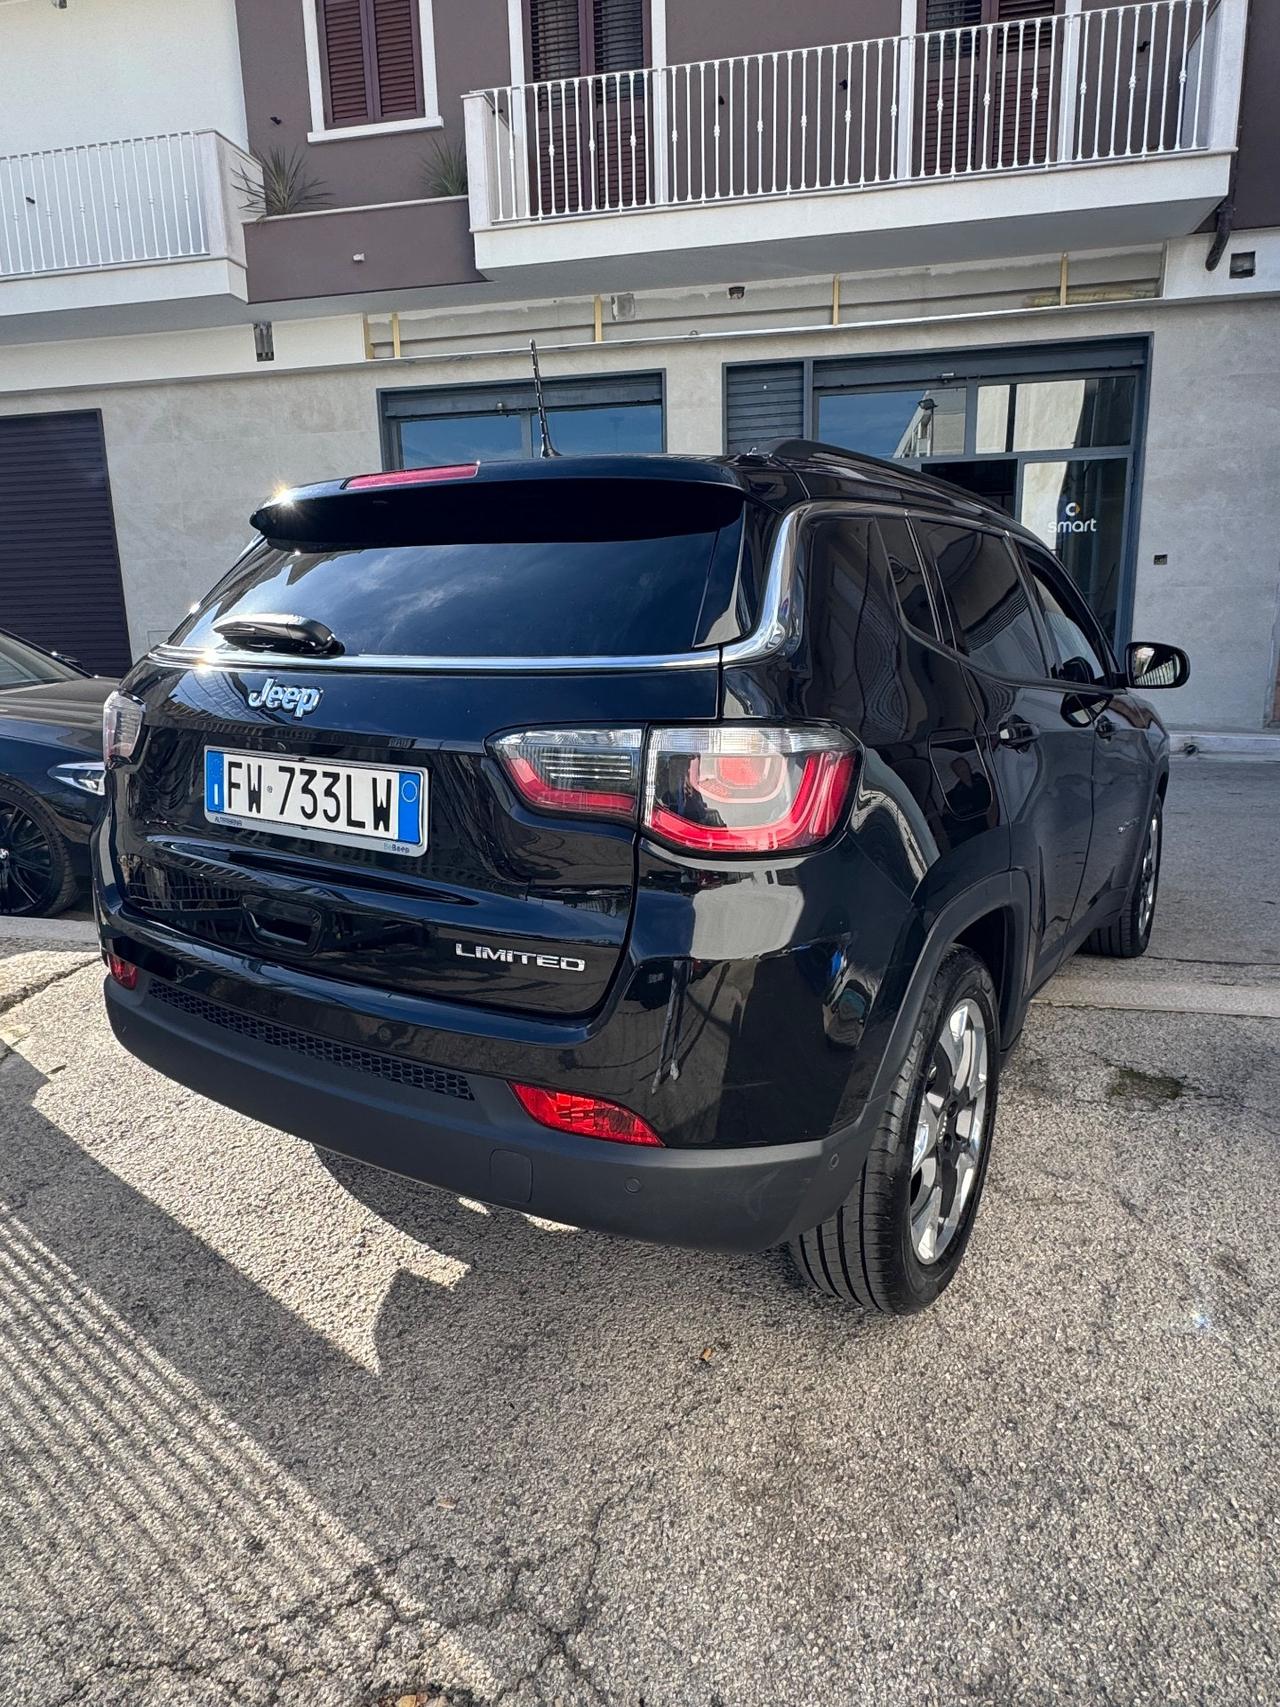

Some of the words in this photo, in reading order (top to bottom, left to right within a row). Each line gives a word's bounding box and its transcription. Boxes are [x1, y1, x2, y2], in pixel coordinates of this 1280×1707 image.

[1047, 518, 1097, 533] smart
[249, 677, 323, 719] Jeep
[228, 761, 263, 814] FW
[278, 765, 392, 832] 733LW
[455, 943, 586, 972] LIMITED
